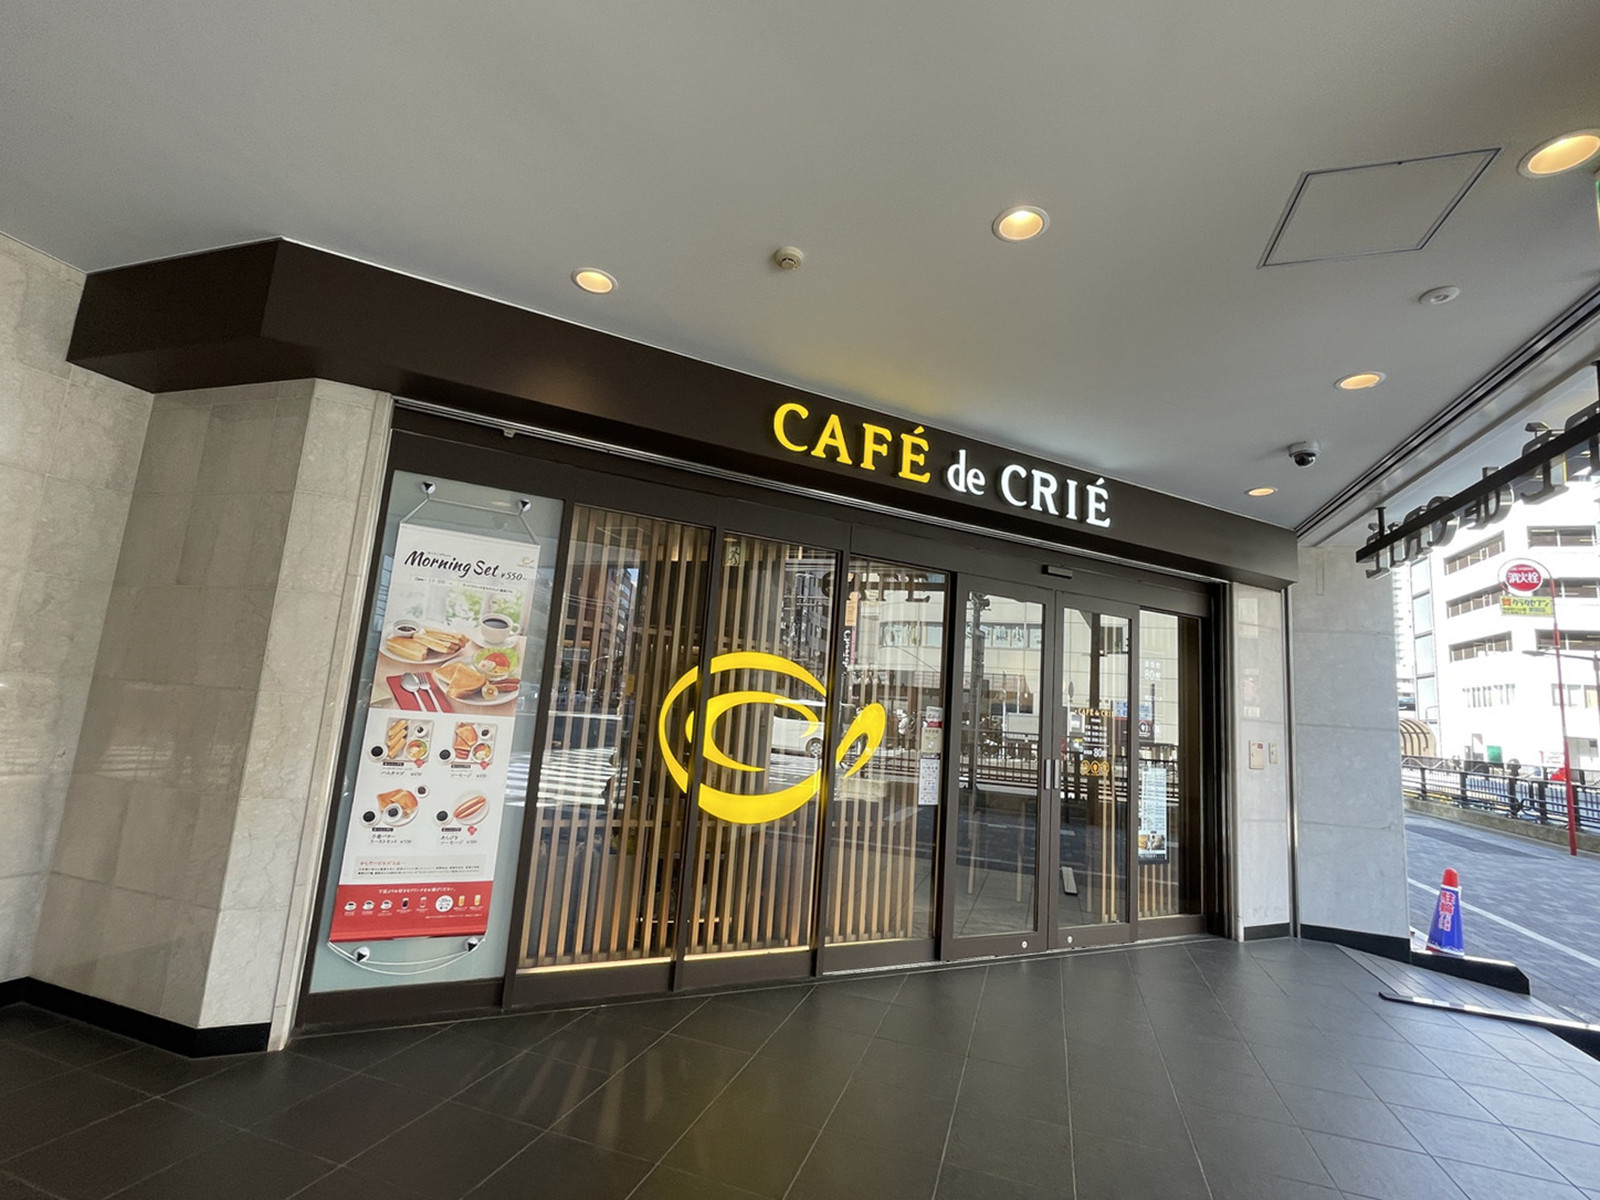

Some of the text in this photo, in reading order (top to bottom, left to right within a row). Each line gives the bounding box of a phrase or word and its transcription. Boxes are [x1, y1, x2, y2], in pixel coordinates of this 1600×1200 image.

[773, 402, 1111, 528] CAFÉ de CRIÉ
[404, 550, 472, 578] Morning
[473, 560, 500, 578] Set
[1507, 571, 1540, 584] 消火栓
